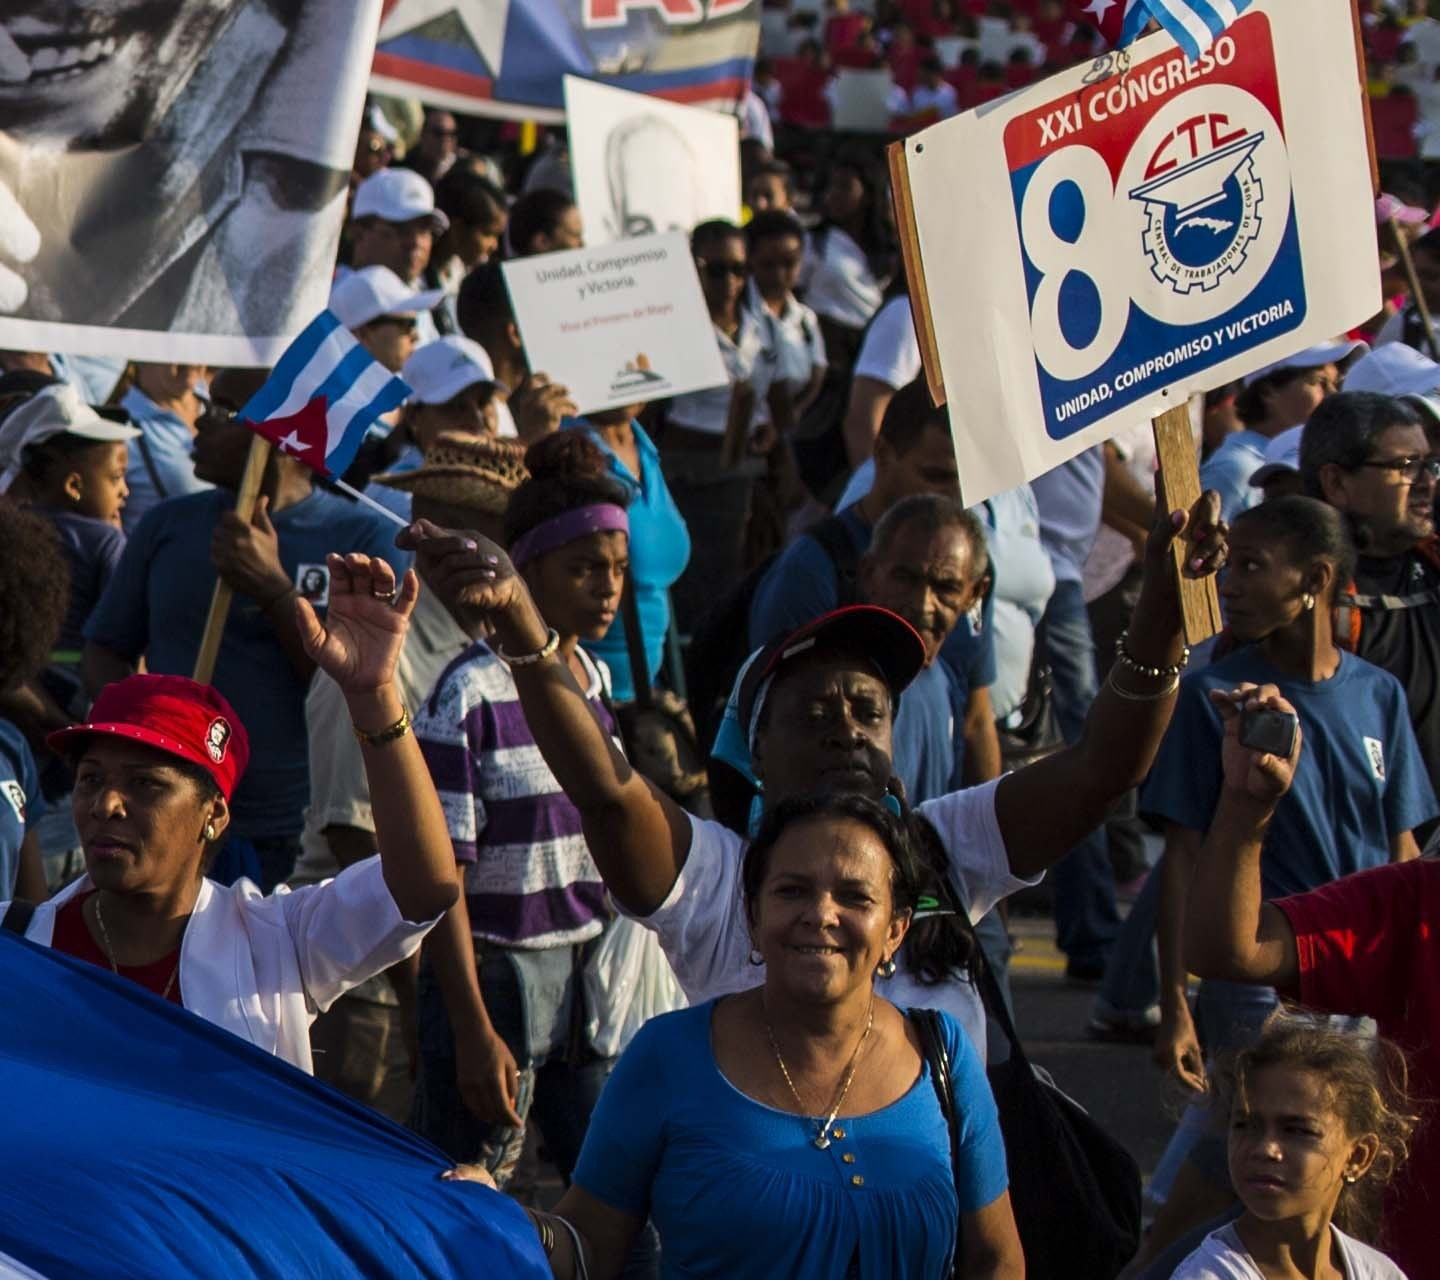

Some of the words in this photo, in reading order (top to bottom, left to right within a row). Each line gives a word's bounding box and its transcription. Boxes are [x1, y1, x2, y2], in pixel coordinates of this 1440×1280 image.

[1036, 98, 1083, 147] XXI
[1088, 36, 1236, 122] CONGRESO
[1143, 113, 1249, 181] CTC
[587, 247, 668, 274] Compromiso
[1154, 219, 1169, 264] CENTRAL
[1170, 263, 1181, 275] DE
[1184, 234, 1245, 279] TRABAJADORES
[1055, 383, 1113, 422] UNIDAD,
[1114, 334, 1213, 392] COMPROMISO
[1213, 329, 1223, 346] Y
[1225, 299, 1295, 340] VICTORIA
